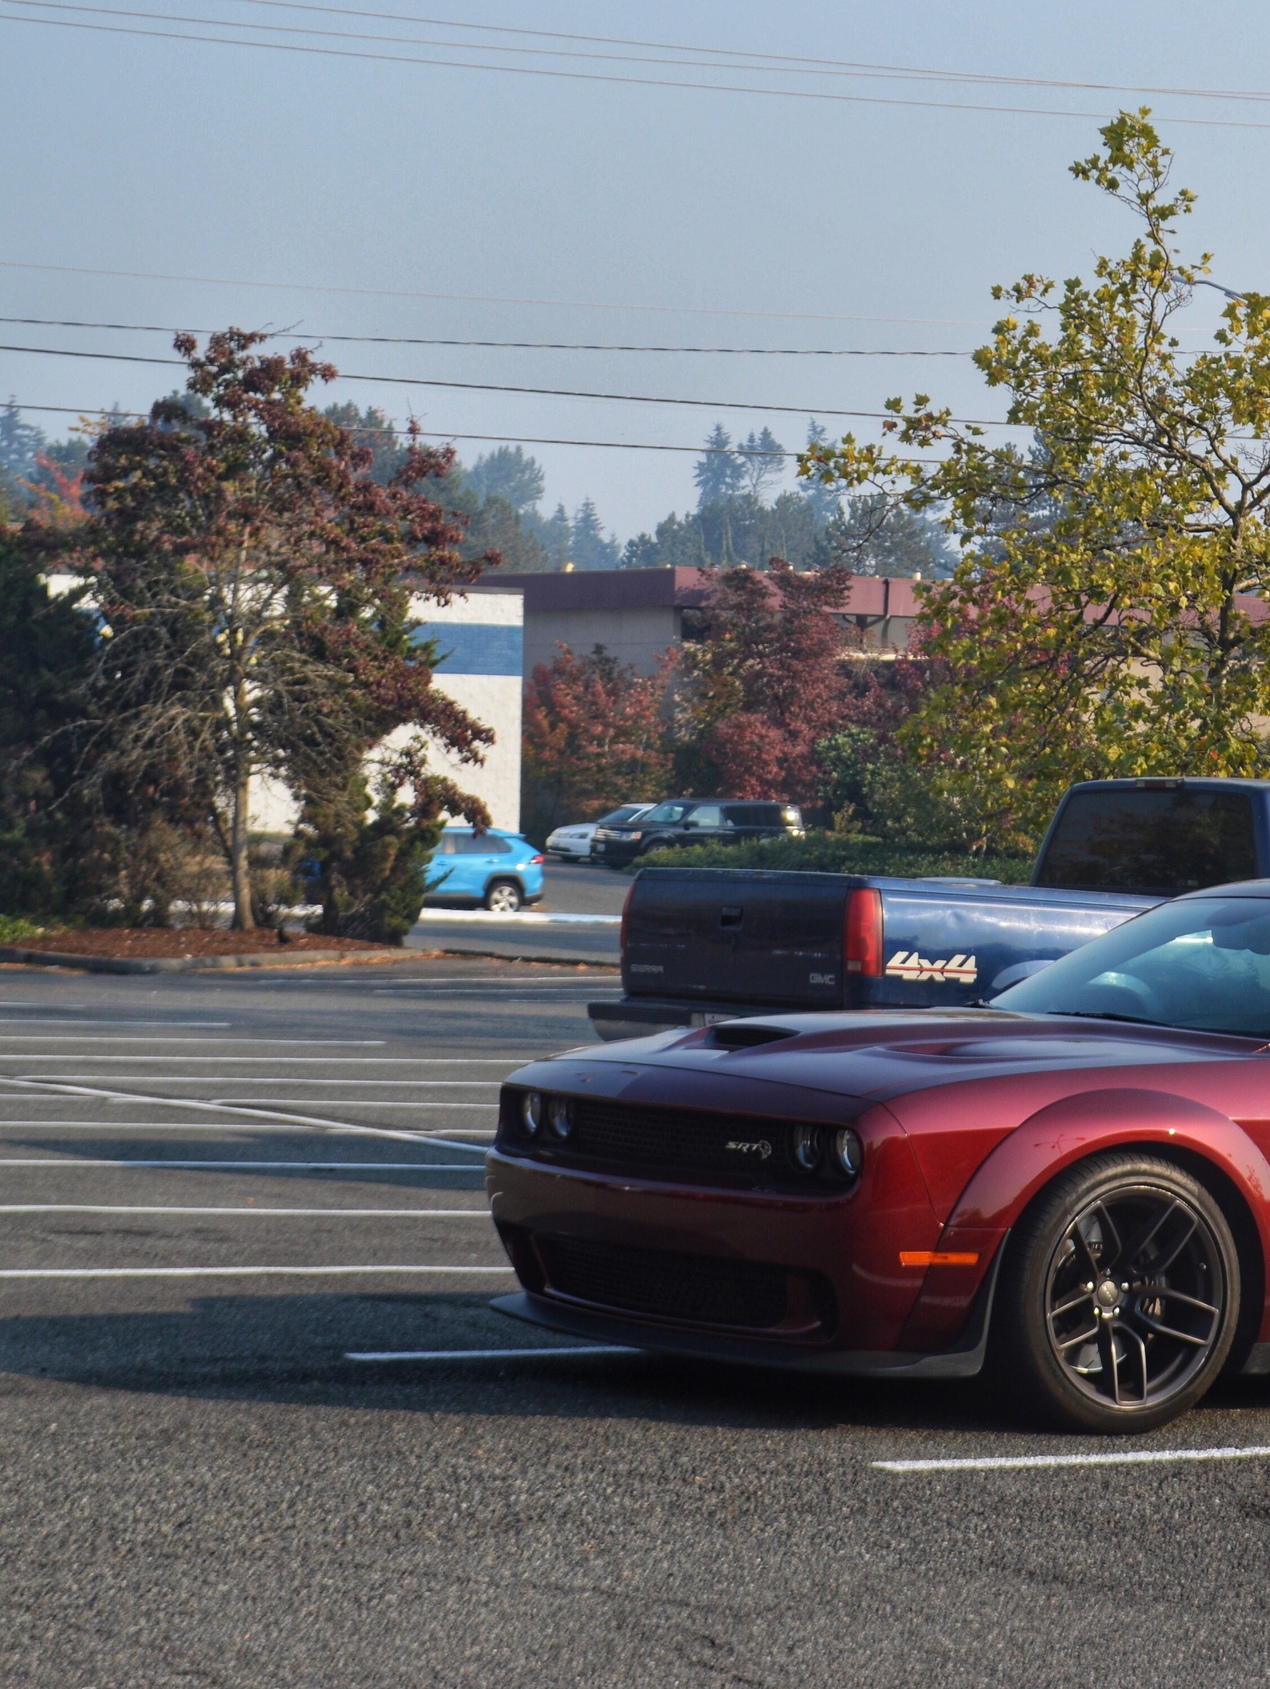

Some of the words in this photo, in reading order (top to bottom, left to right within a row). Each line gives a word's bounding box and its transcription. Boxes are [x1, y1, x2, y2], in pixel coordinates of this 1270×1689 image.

[886, 952, 977, 983] 4x4
[809, 973, 836, 985] GMC
[725, 1141, 762, 1152] SRT
